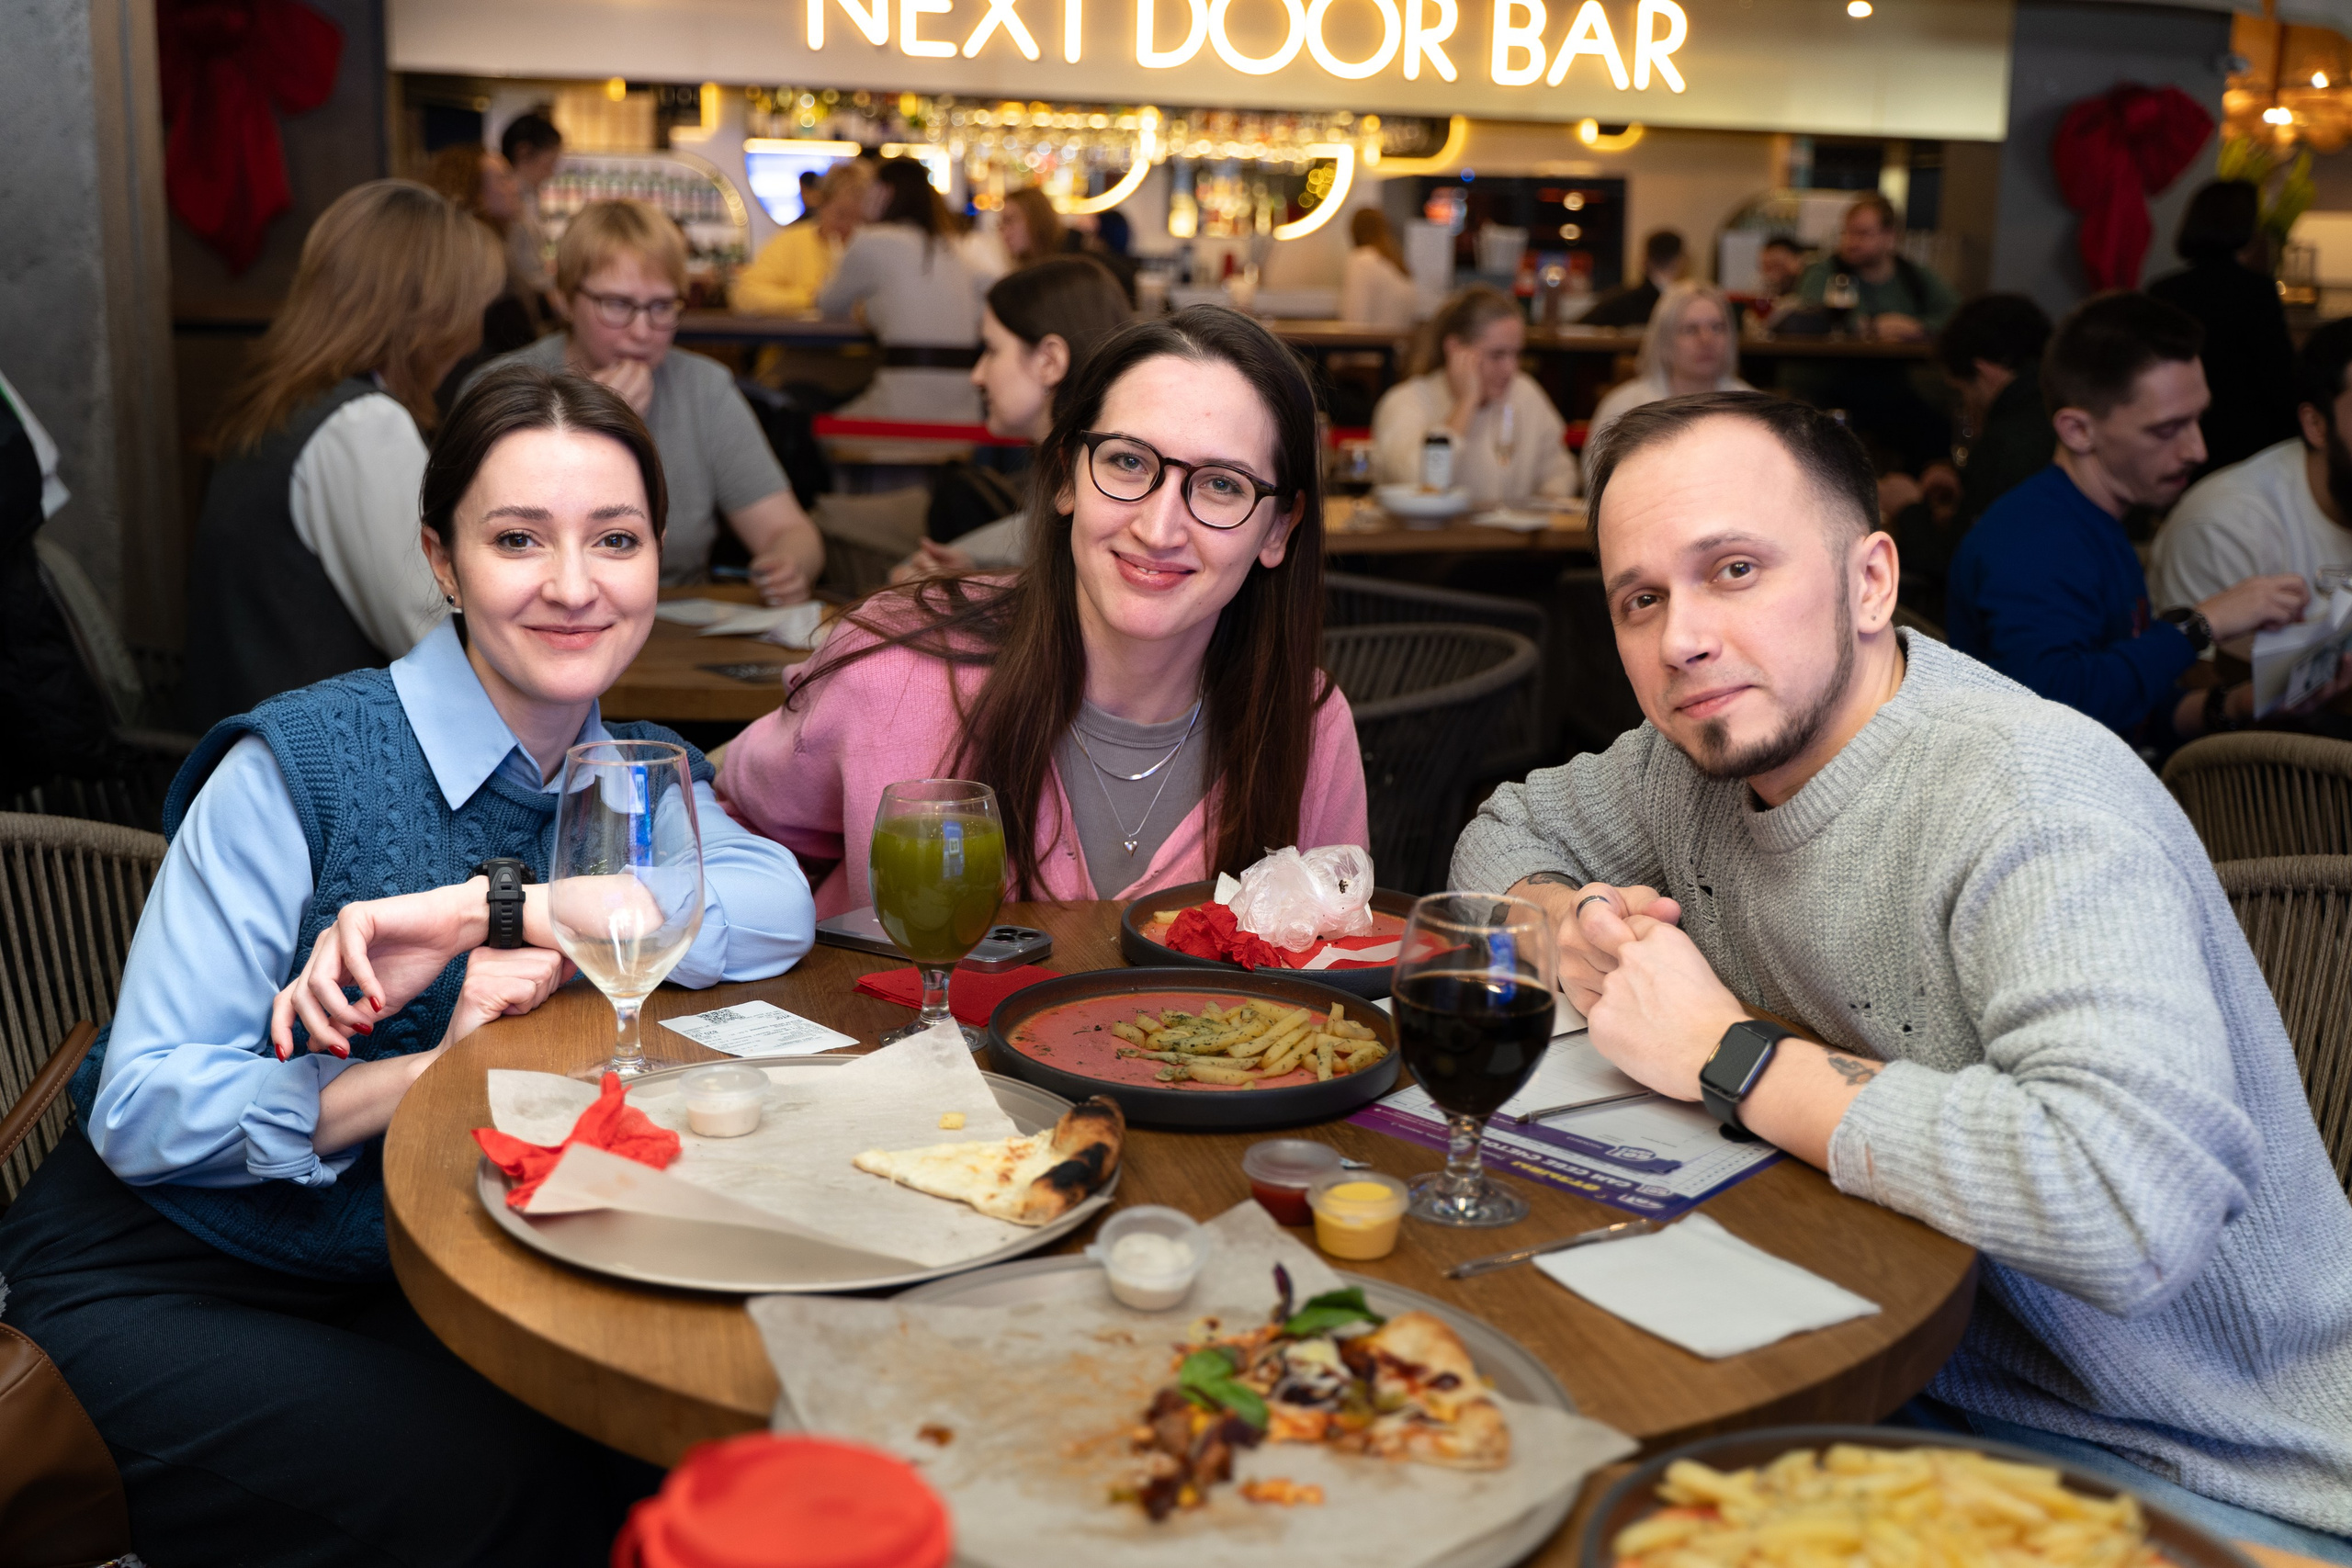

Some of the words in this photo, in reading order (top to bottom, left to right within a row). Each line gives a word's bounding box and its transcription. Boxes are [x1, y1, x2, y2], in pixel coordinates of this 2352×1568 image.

[806, 0, 1082, 64] NEXT
[1136, 0, 1460, 83] DOOR
[1490, 0, 1688, 94] BAR
[1510, 1161, 1601, 1191] ОТЗЫВЫ
[1541, 1158, 1590, 1176] СЕБЕ
[1589, 1174, 1633, 1188] САМ
